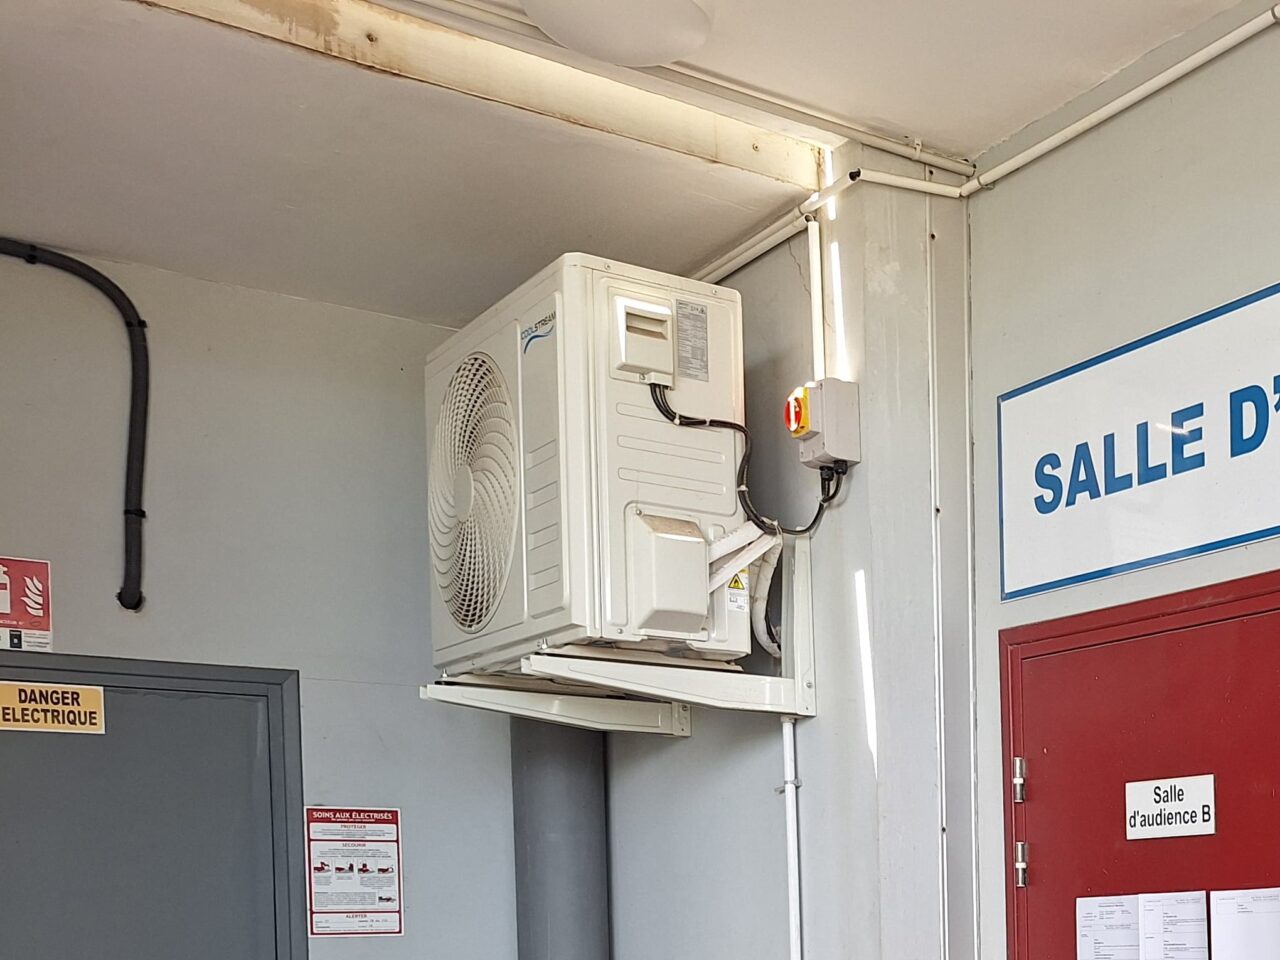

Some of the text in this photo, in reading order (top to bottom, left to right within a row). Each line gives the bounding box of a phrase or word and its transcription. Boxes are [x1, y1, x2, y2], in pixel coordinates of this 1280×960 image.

[521, 310, 557, 341] COOLSTREAM
[1033, 402, 1206, 515] SALLE
[18, 688, 81, 707] DANGER
[2, 706, 98, 726] ELECTRIQUE
[1153, 784, 1185, 804] Salle
[312, 811, 393, 820] SOINS AUX ÉLECTRISÉS
[1129, 804, 1212, 828] d'audience B
